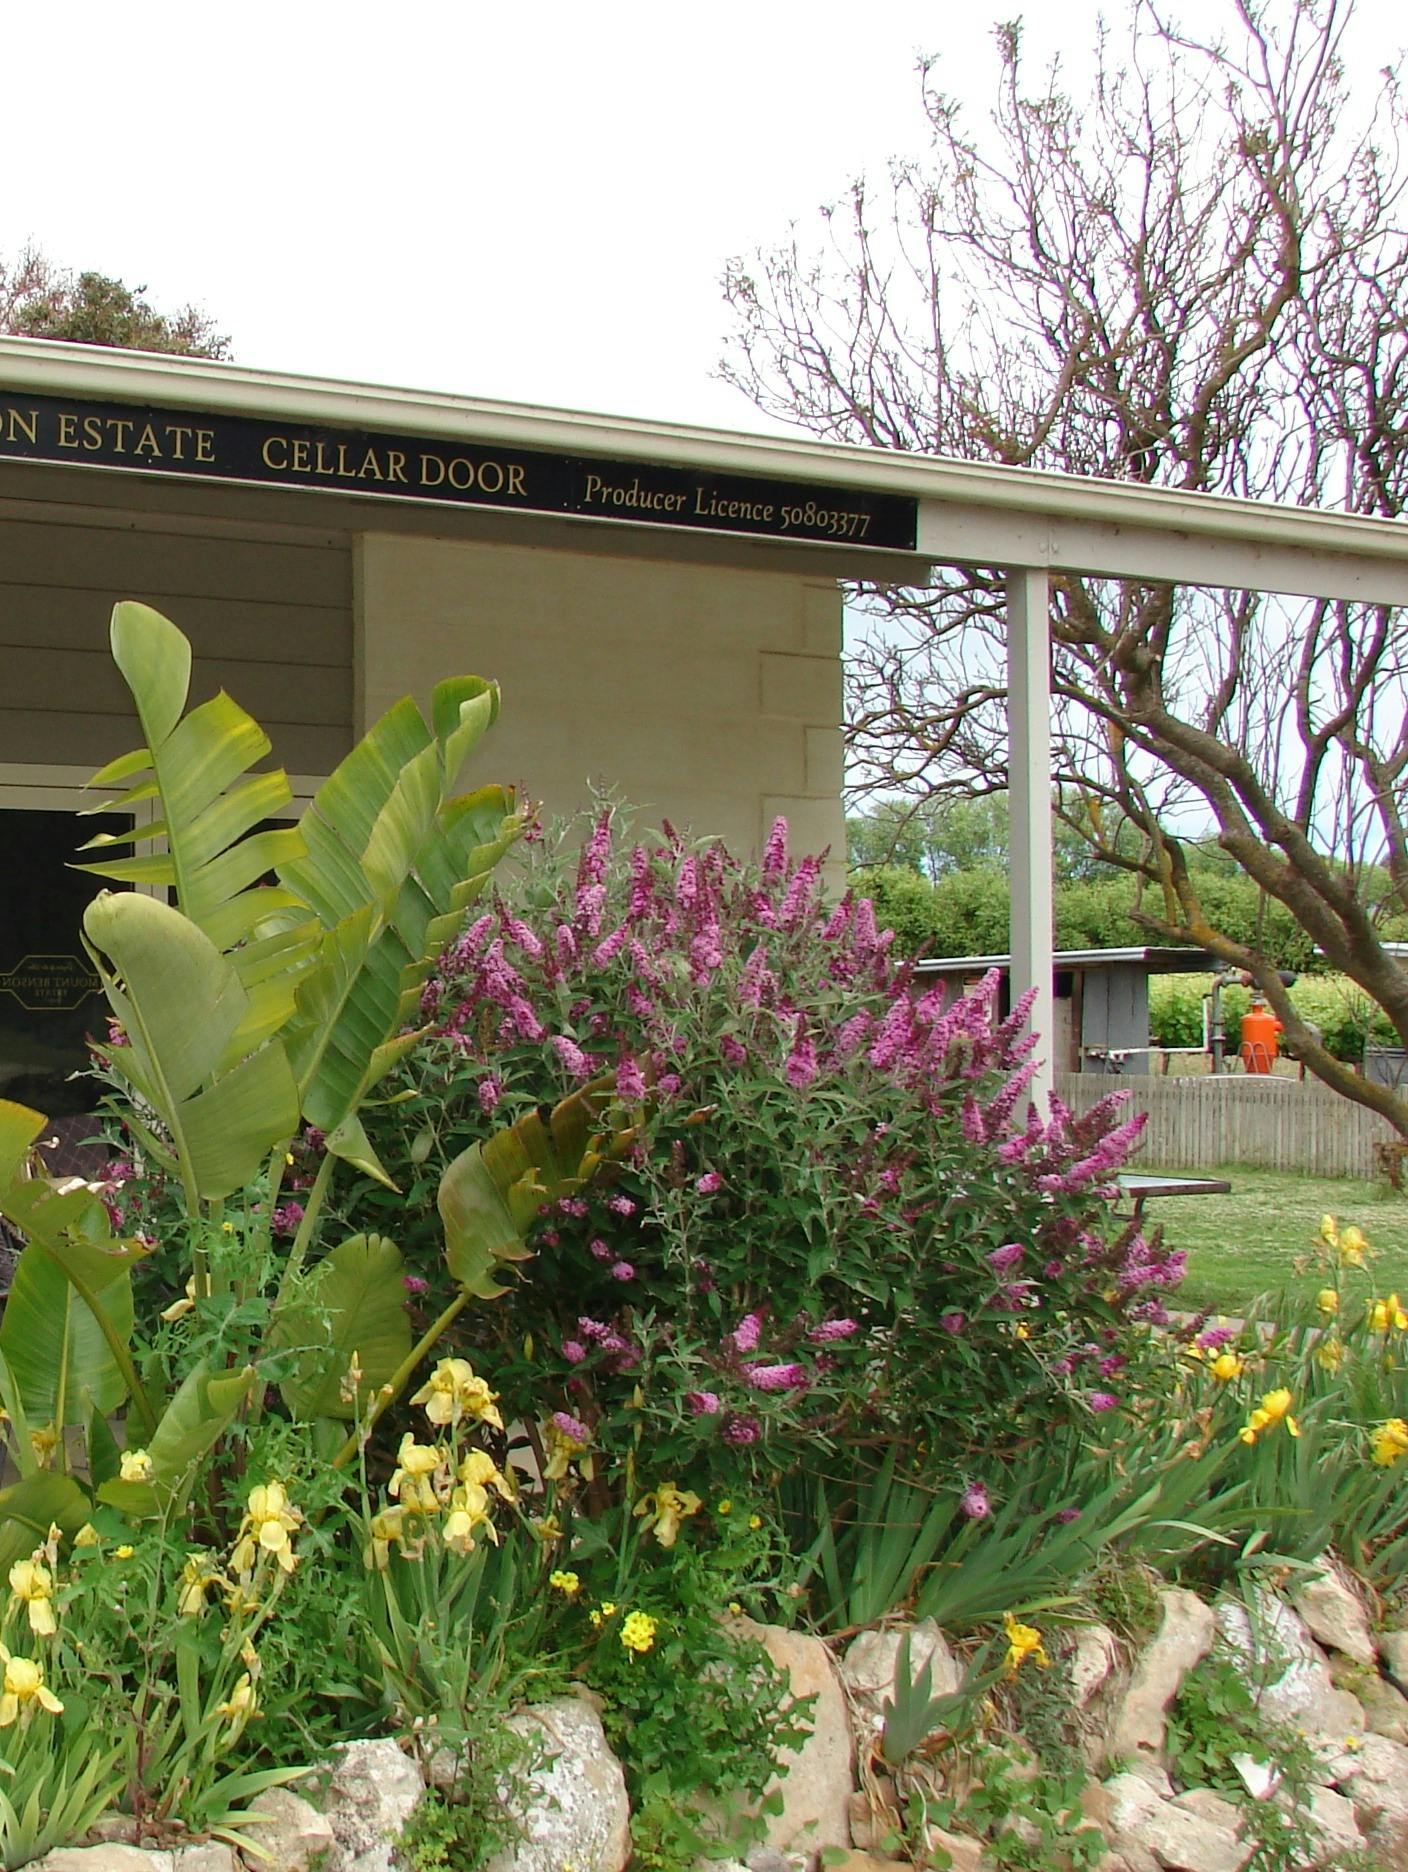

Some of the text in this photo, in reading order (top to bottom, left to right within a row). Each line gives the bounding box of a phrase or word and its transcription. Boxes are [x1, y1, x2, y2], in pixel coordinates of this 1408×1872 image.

[58, 413, 216, 463] ESTATE
[262, 436, 528, 496] CELLAR DOOR
[583, 475, 871, 537] Producer Licence 50803377
